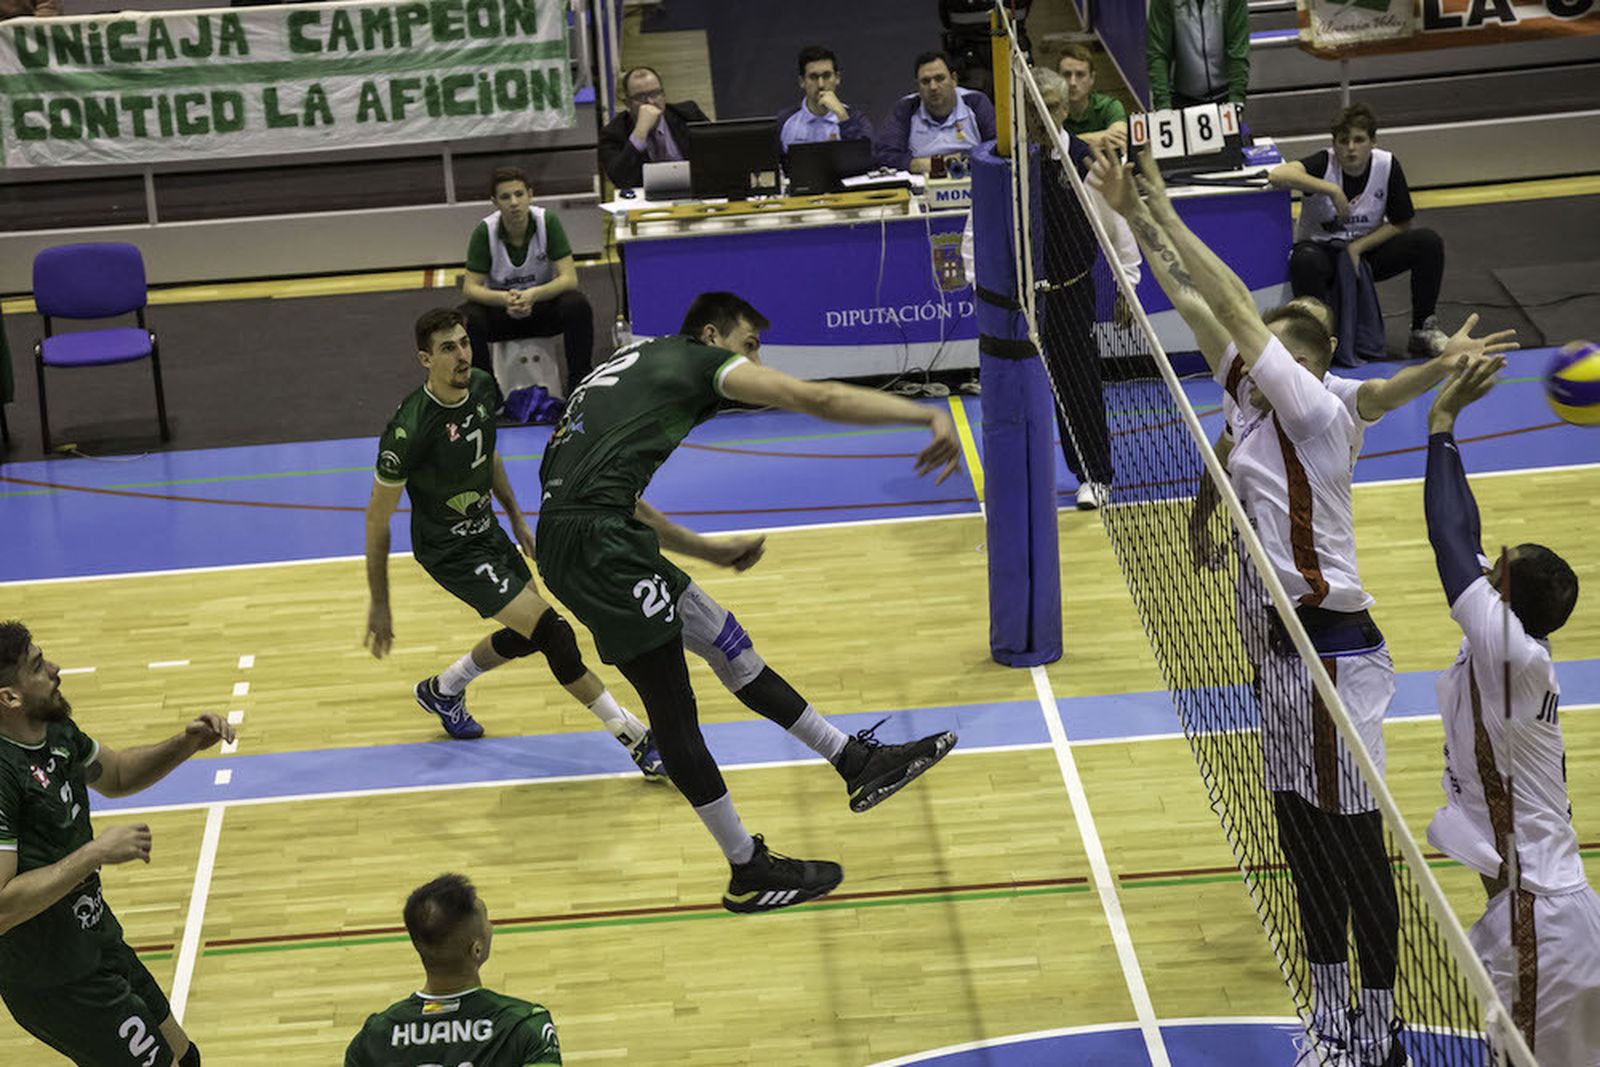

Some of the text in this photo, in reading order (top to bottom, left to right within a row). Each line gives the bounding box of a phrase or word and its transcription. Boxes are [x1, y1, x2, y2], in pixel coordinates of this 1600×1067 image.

[287, 0, 538, 54] CAMPEON
[12, 91, 246, 140] CONTIGO
[262, 82, 335, 128] LA
[1133, 110, 1233, 148] 0 5 8 1
[825, 299, 951, 328] DIPUTACIÓN
[391, 1019, 493, 1046] HUANG
